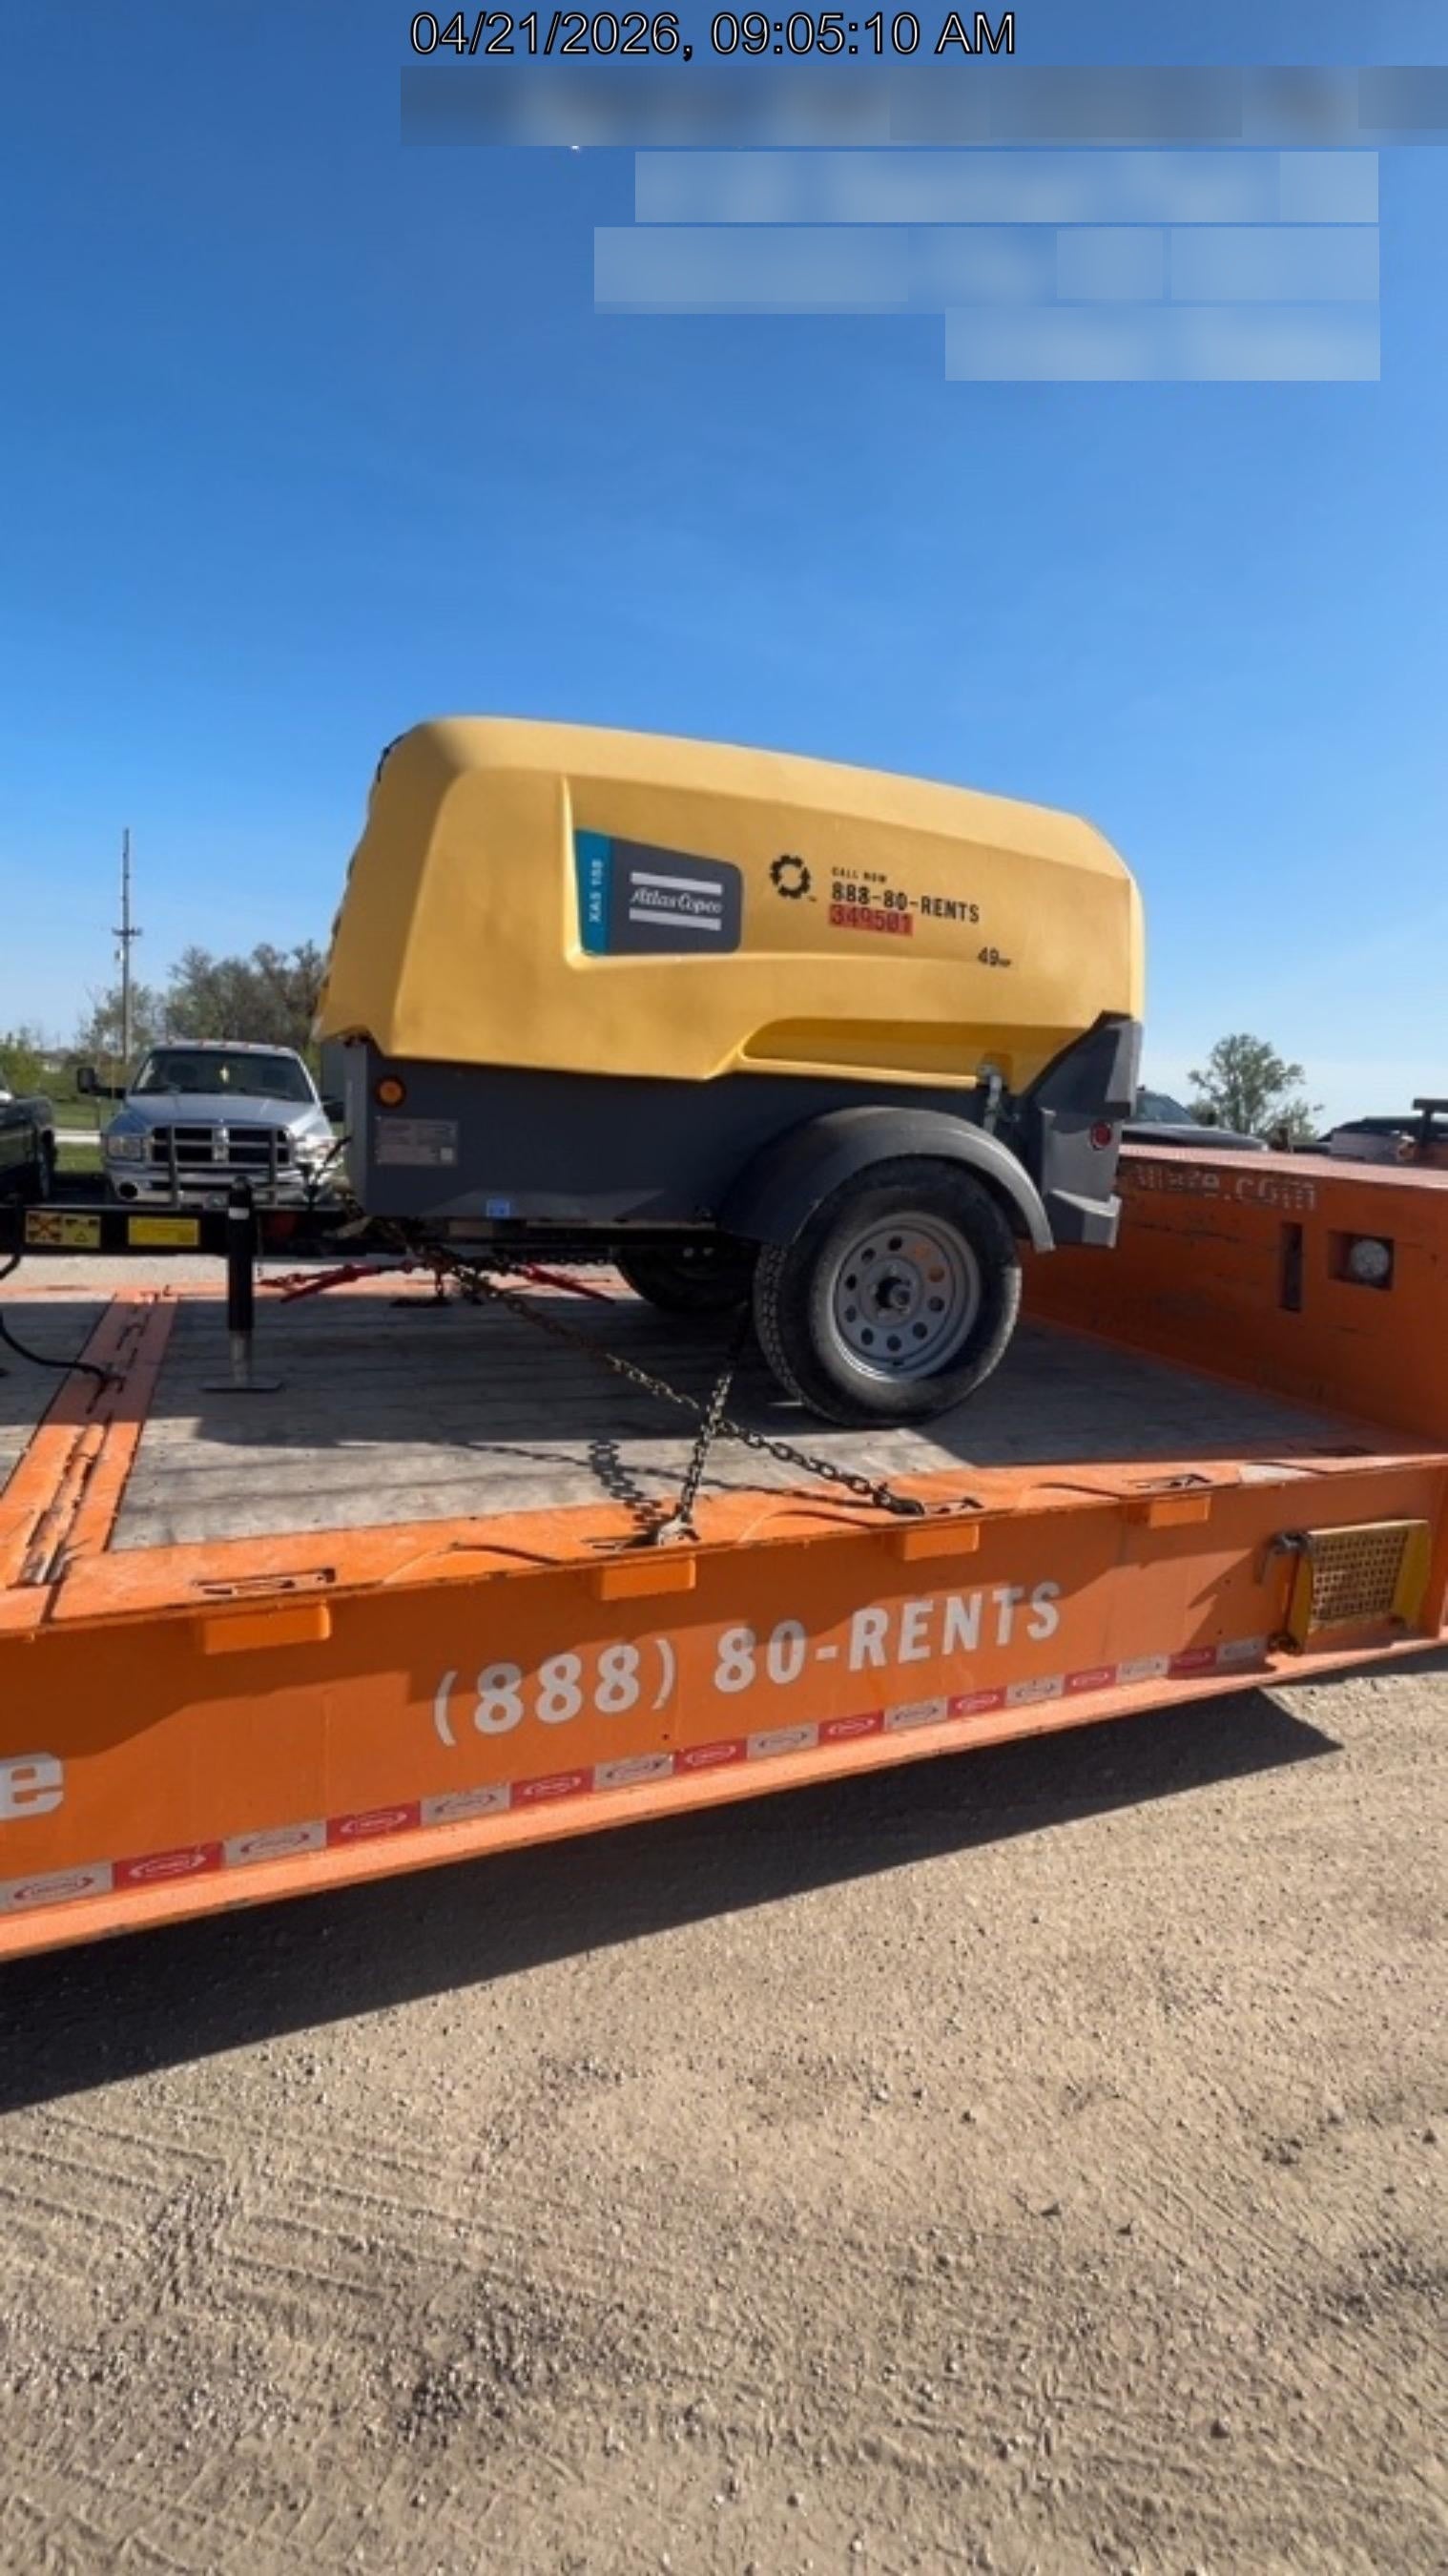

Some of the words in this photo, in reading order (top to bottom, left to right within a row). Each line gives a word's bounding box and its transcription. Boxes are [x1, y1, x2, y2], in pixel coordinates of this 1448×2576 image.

[832, 866, 858, 880] CALL
[863, 871, 887, 883] NOW
[832, 882, 981, 924] 888-80-RENTS
[434, 1638, 676, 1748] (888)
[714, 1582, 1061, 1693] 80-RENTS
